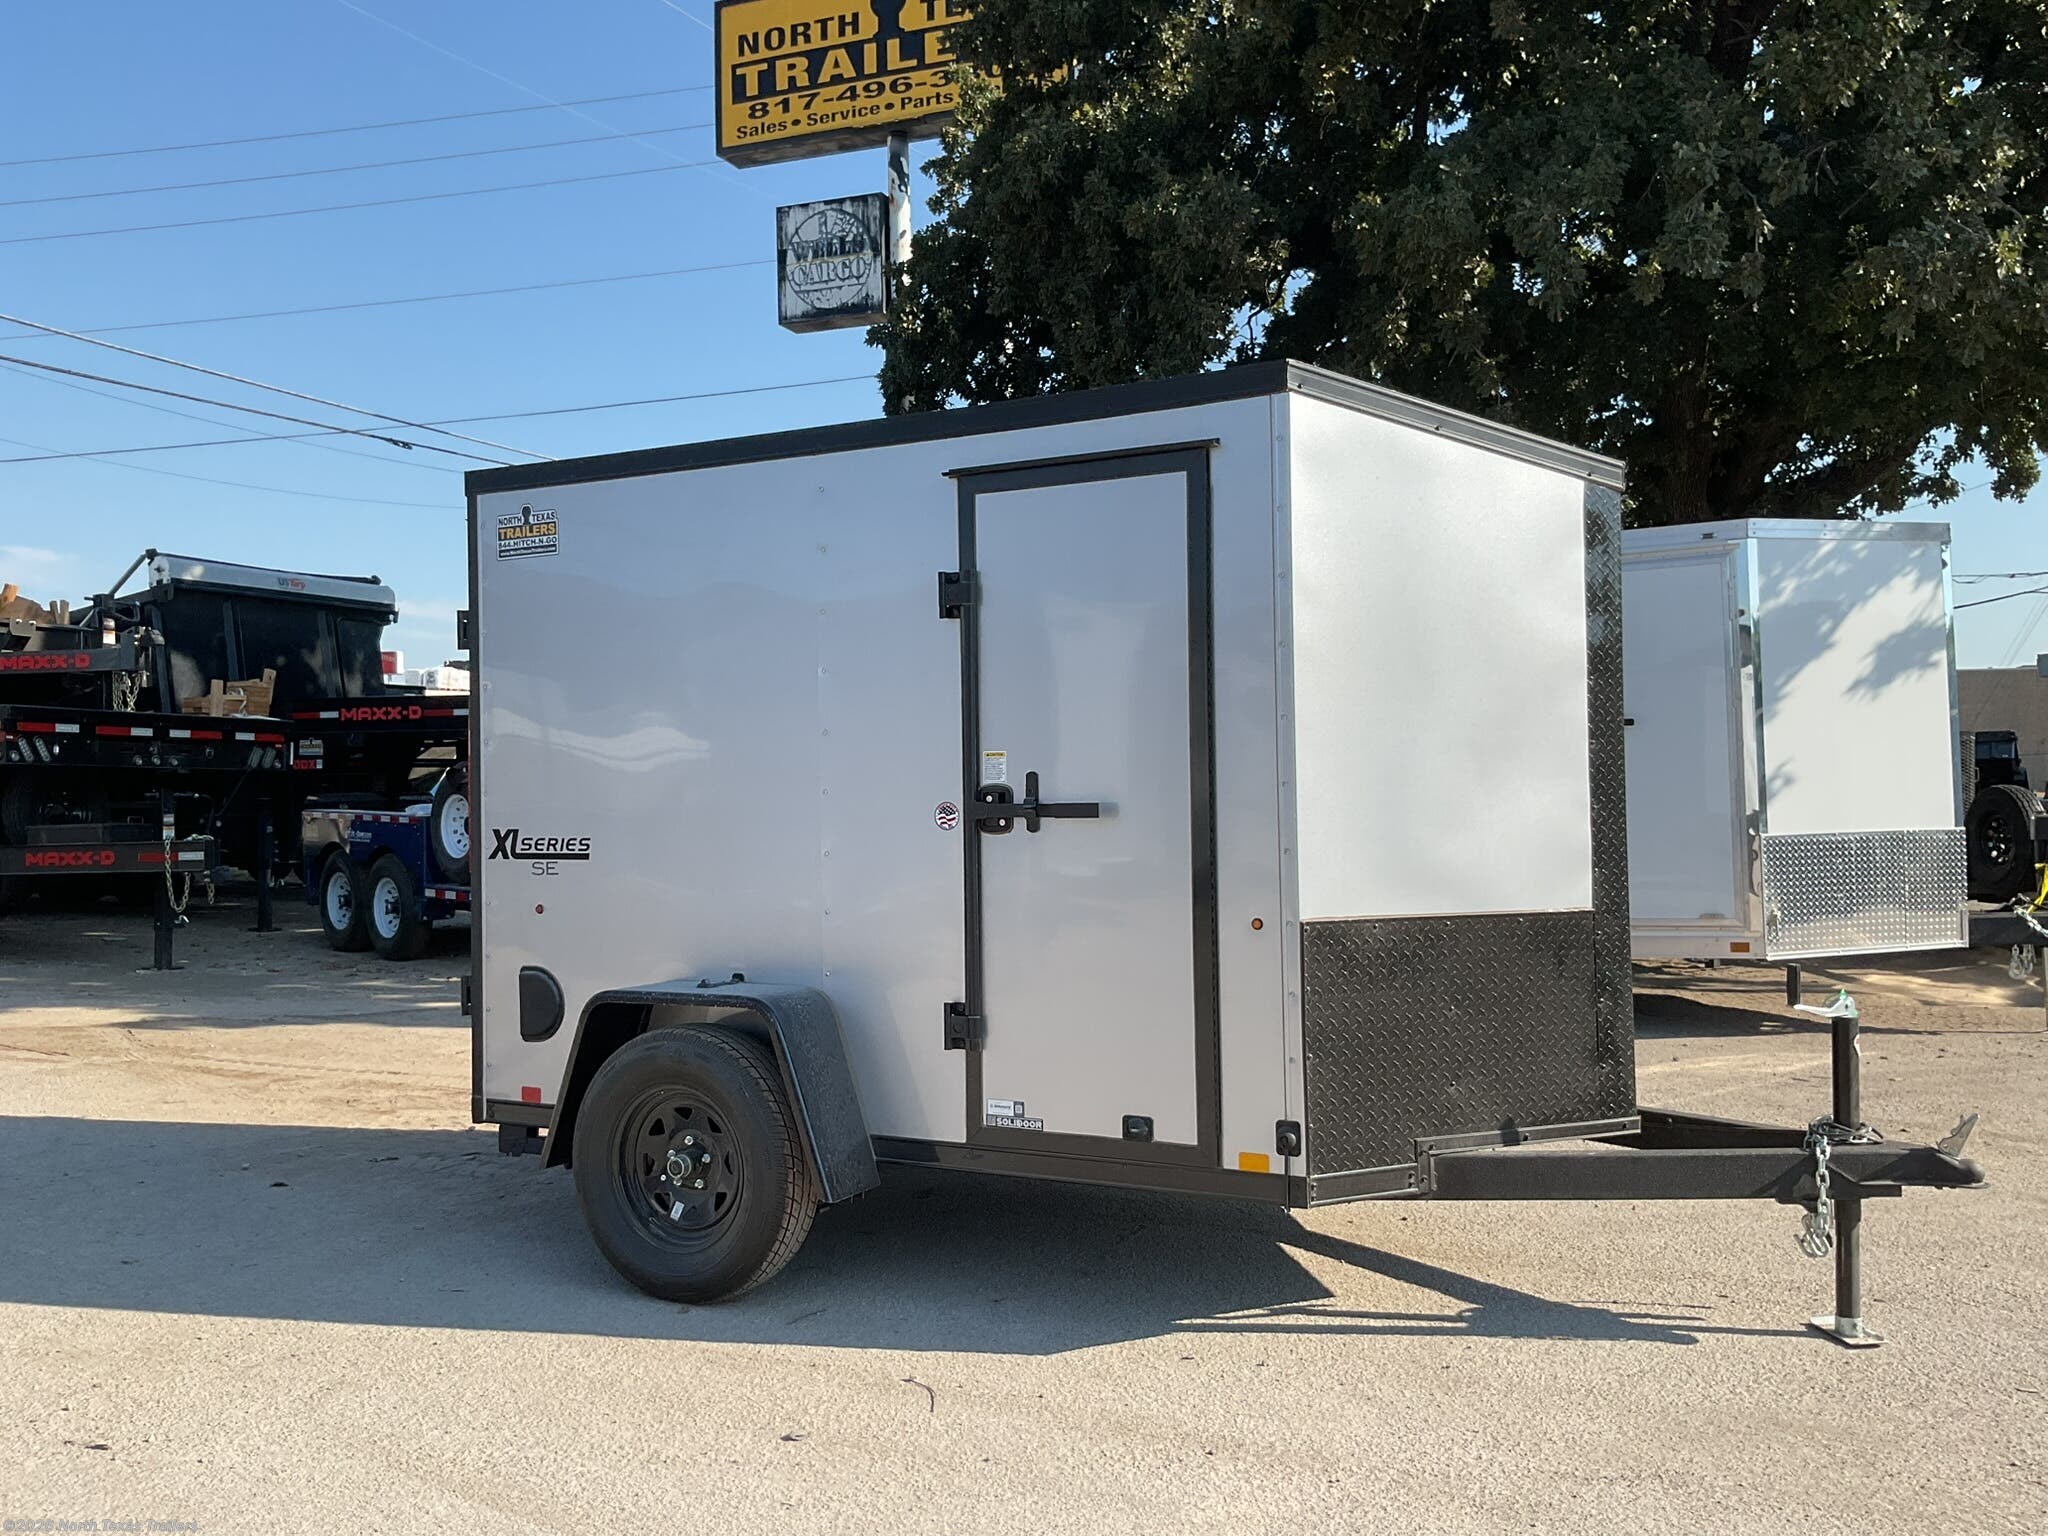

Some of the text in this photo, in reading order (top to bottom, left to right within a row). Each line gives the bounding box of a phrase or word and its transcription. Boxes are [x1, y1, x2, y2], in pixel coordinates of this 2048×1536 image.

[738, 12, 859, 57] NORTH
[735, 31, 956, 97] TRAILE
[748, 70, 953, 120] 817-496-3
[736, 91, 954, 139] Sales Service Parts
[792, 257, 867, 286] CARGO
[498, 512, 556, 526] NORTH TEXAS
[499, 523, 556, 540] TRAILERS
[0, 653, 90, 670] MAXX-D
[341, 705, 422, 721] MAXX-D
[520, 837, 591, 852] SERIES
[25, 850, 116, 867] MAXX-D
[531, 861, 559, 876] SE
[997, 1117, 1042, 1129] SOLIDOOR
